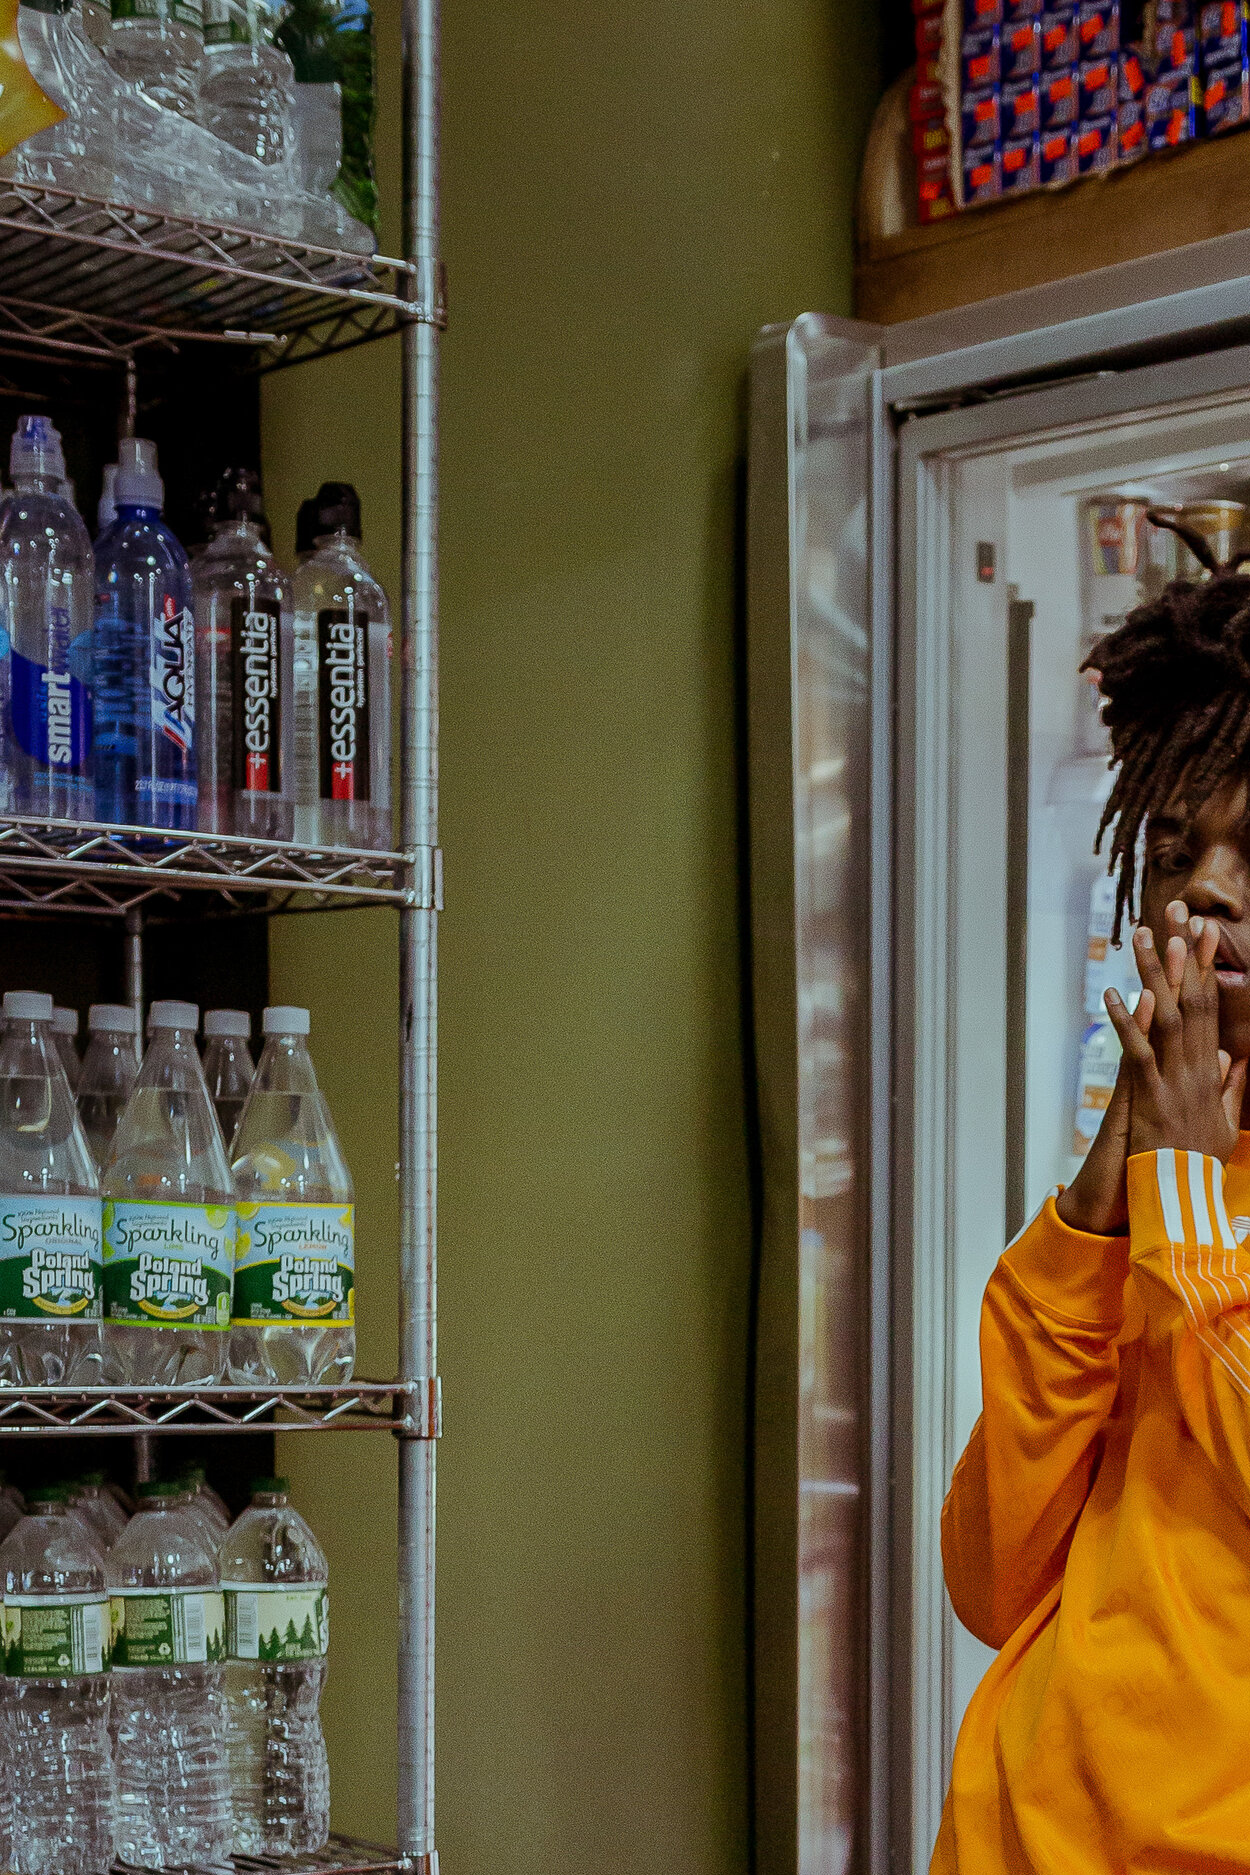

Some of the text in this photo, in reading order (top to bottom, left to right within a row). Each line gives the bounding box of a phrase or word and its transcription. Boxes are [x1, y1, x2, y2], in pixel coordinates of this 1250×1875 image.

[163, 612, 186, 720] AQUA
[240, 610, 271, 752] essentia
[325, 622, 357, 762] essentia
[2, 1212, 99, 1252] Sparkling
[116, 1219, 219, 1260] Sparkling
[254, 1219, 349, 1257] Sparkling
[32, 1248, 90, 1269] Poland
[139, 1252, 202, 1275] Poland
[280, 1254, 338, 1274] Poland
[23, 1266, 96, 1300] Spring
[130, 1270, 209, 1306] Spring
[272, 1271, 344, 1302] Spring
